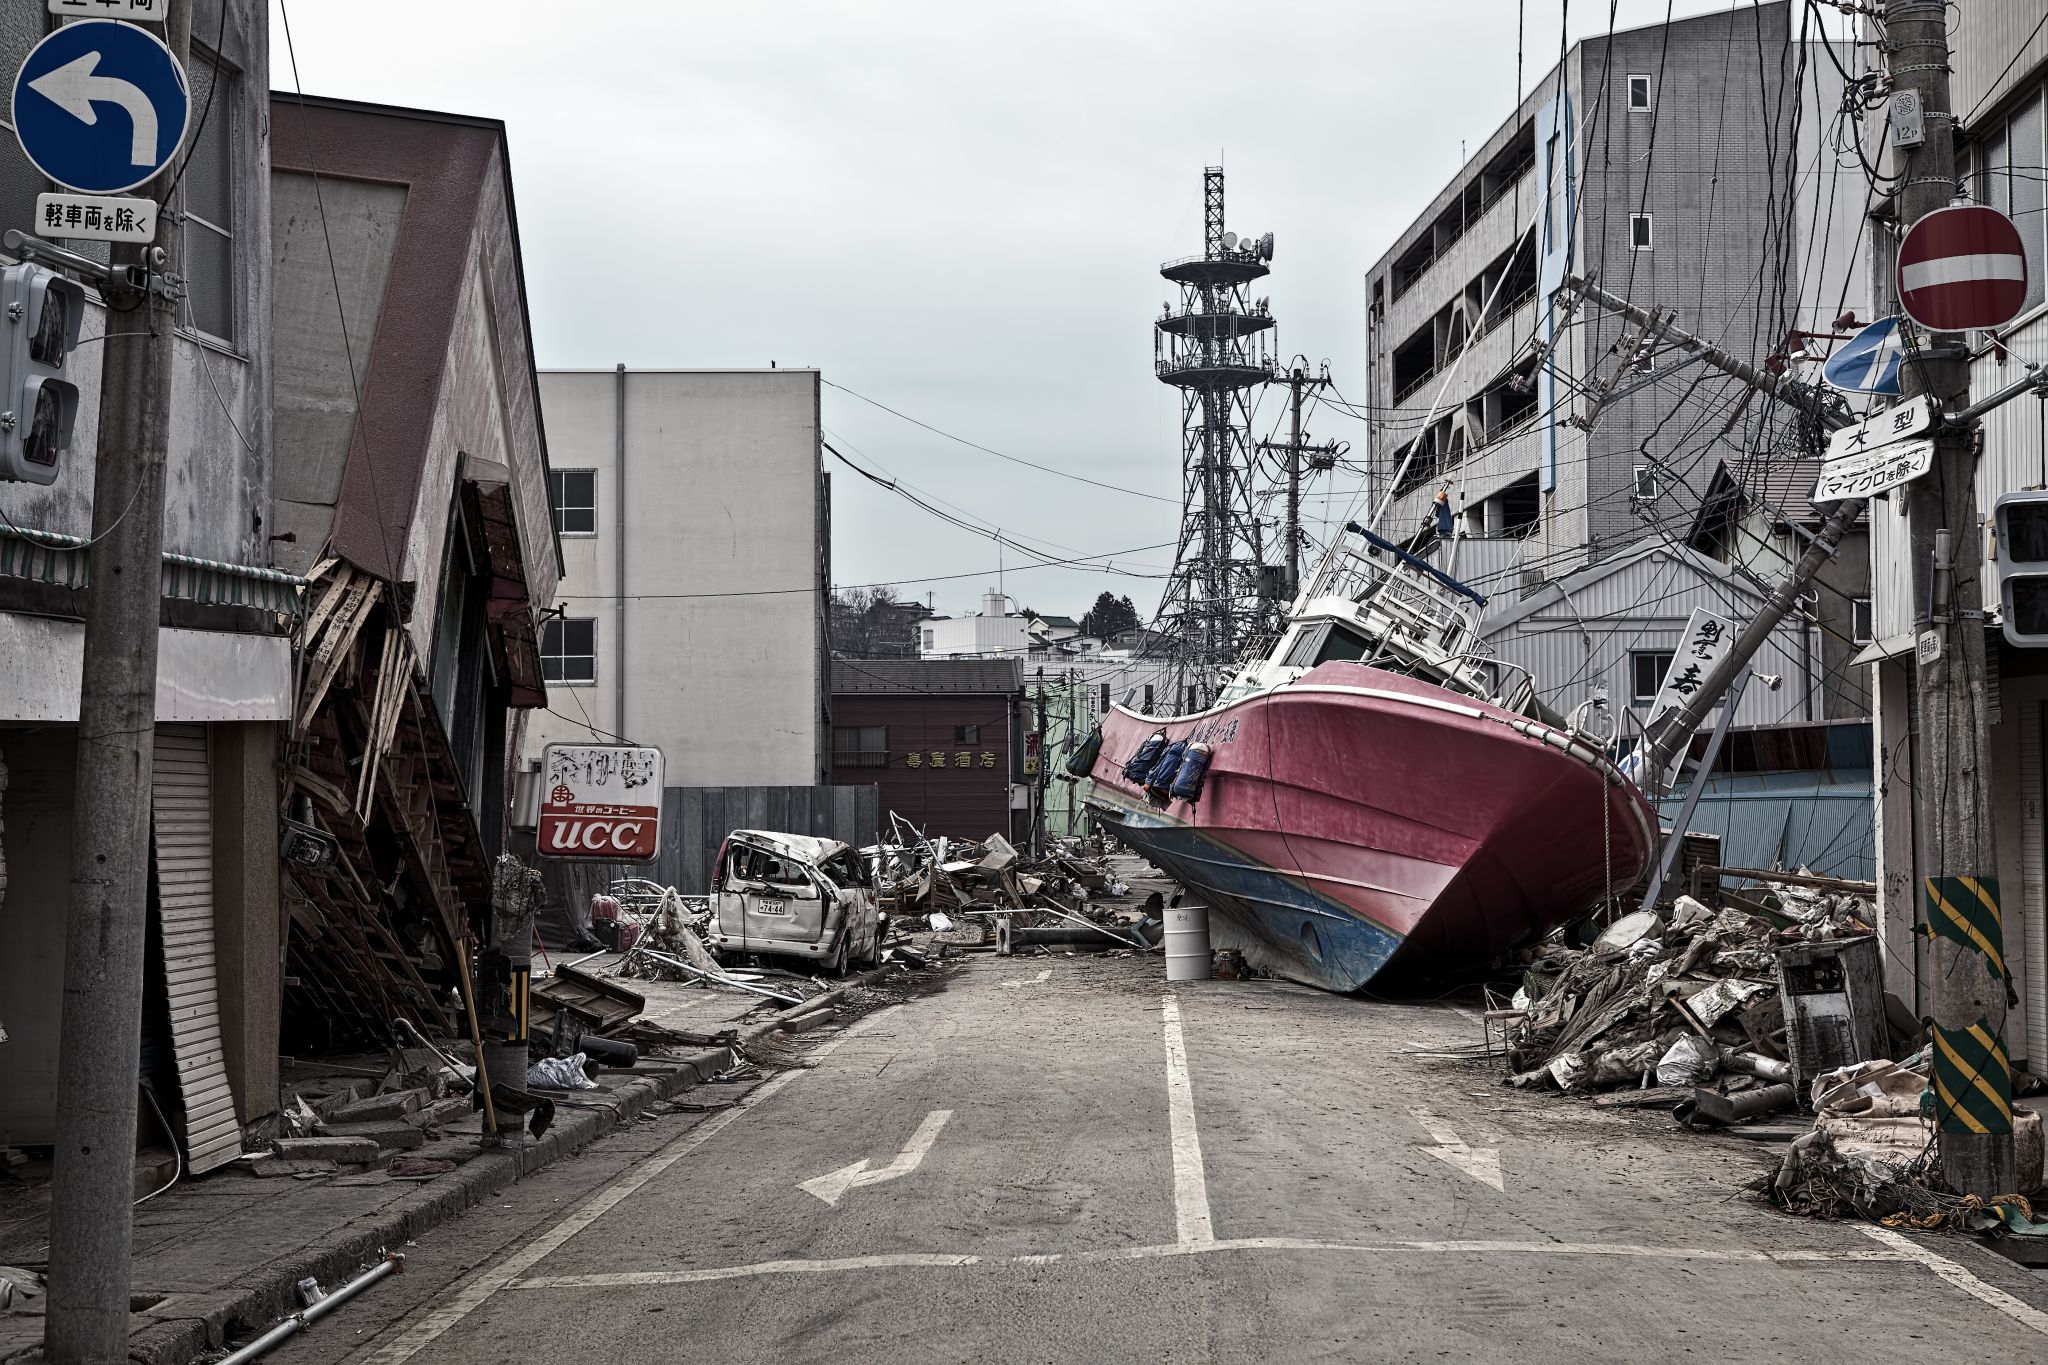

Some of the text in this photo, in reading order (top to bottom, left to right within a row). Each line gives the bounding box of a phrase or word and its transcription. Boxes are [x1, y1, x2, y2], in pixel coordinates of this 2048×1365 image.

[45, 203, 146, 233] 軽車両を除く
[1845, 407, 1915, 450] 大型
[574, 805, 637, 815] 世界のコーヒー
